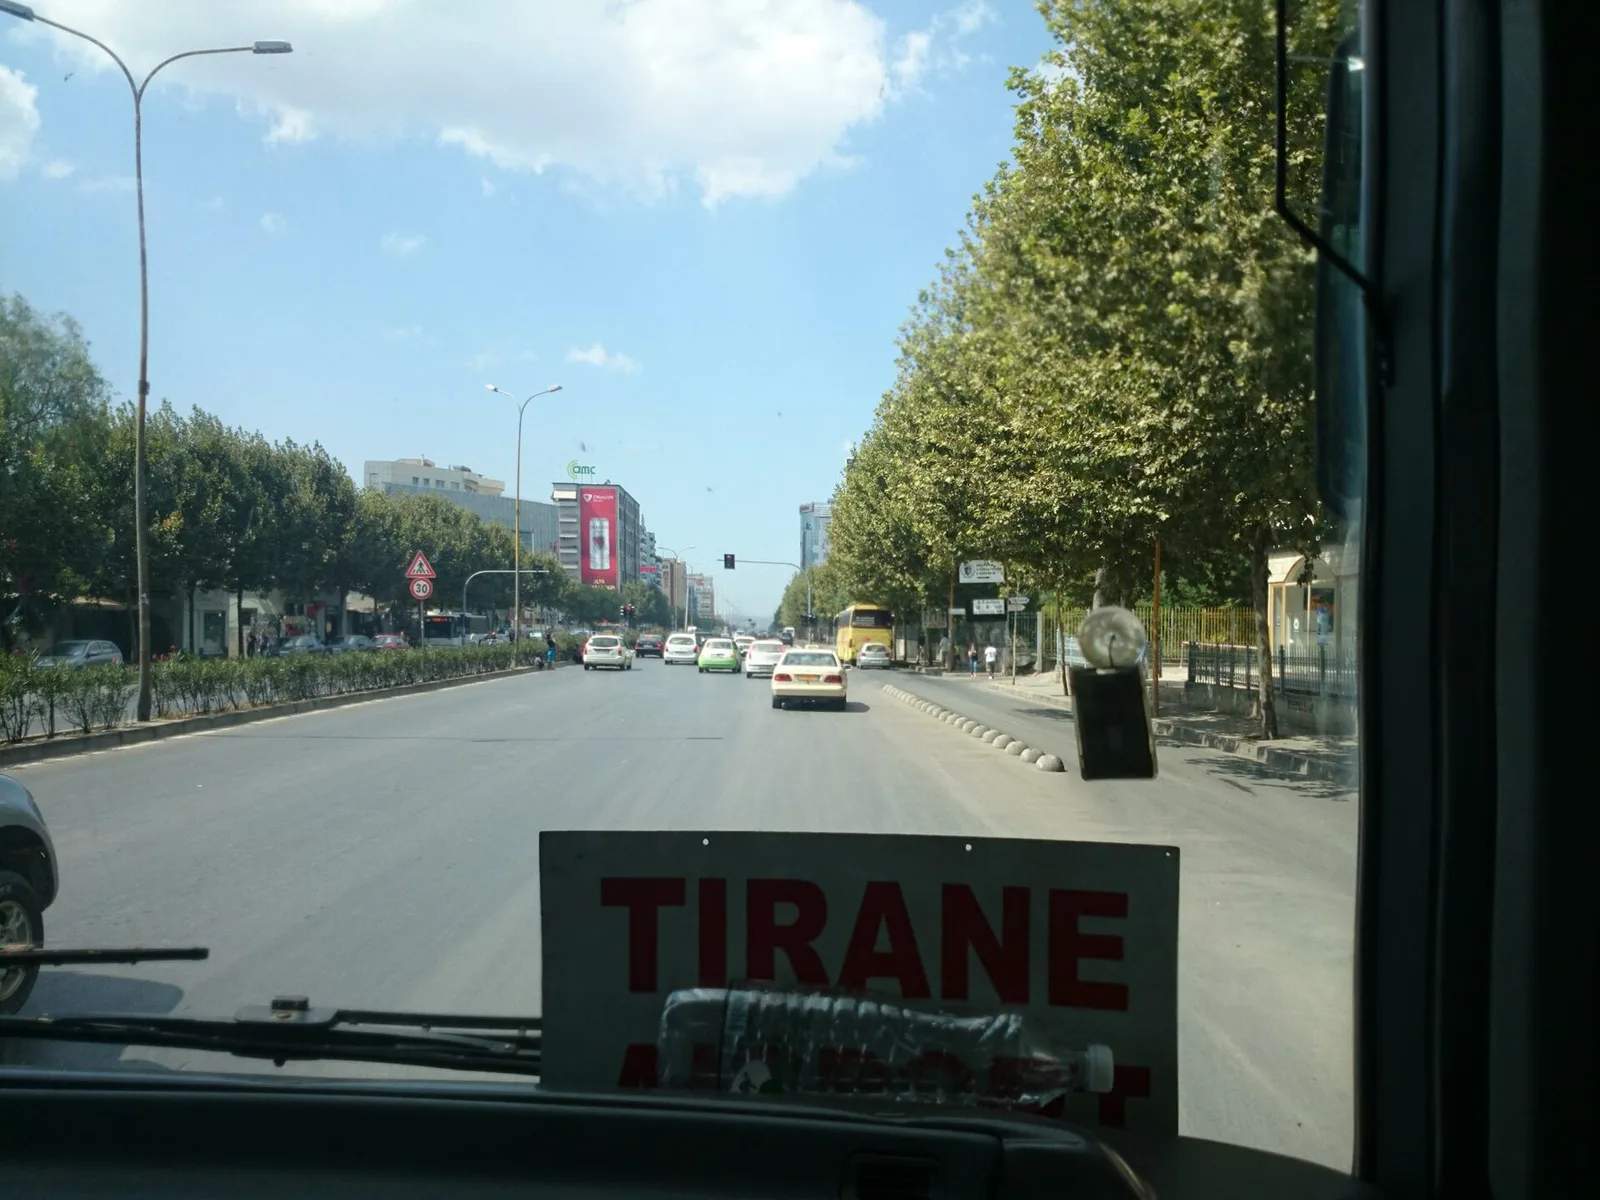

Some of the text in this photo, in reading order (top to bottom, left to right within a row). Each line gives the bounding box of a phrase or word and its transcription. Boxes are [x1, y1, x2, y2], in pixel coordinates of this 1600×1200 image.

[573, 466, 596, 475] amc
[415, 584, 427, 593] 30
[601, 877, 1128, 1011] TIRANE
